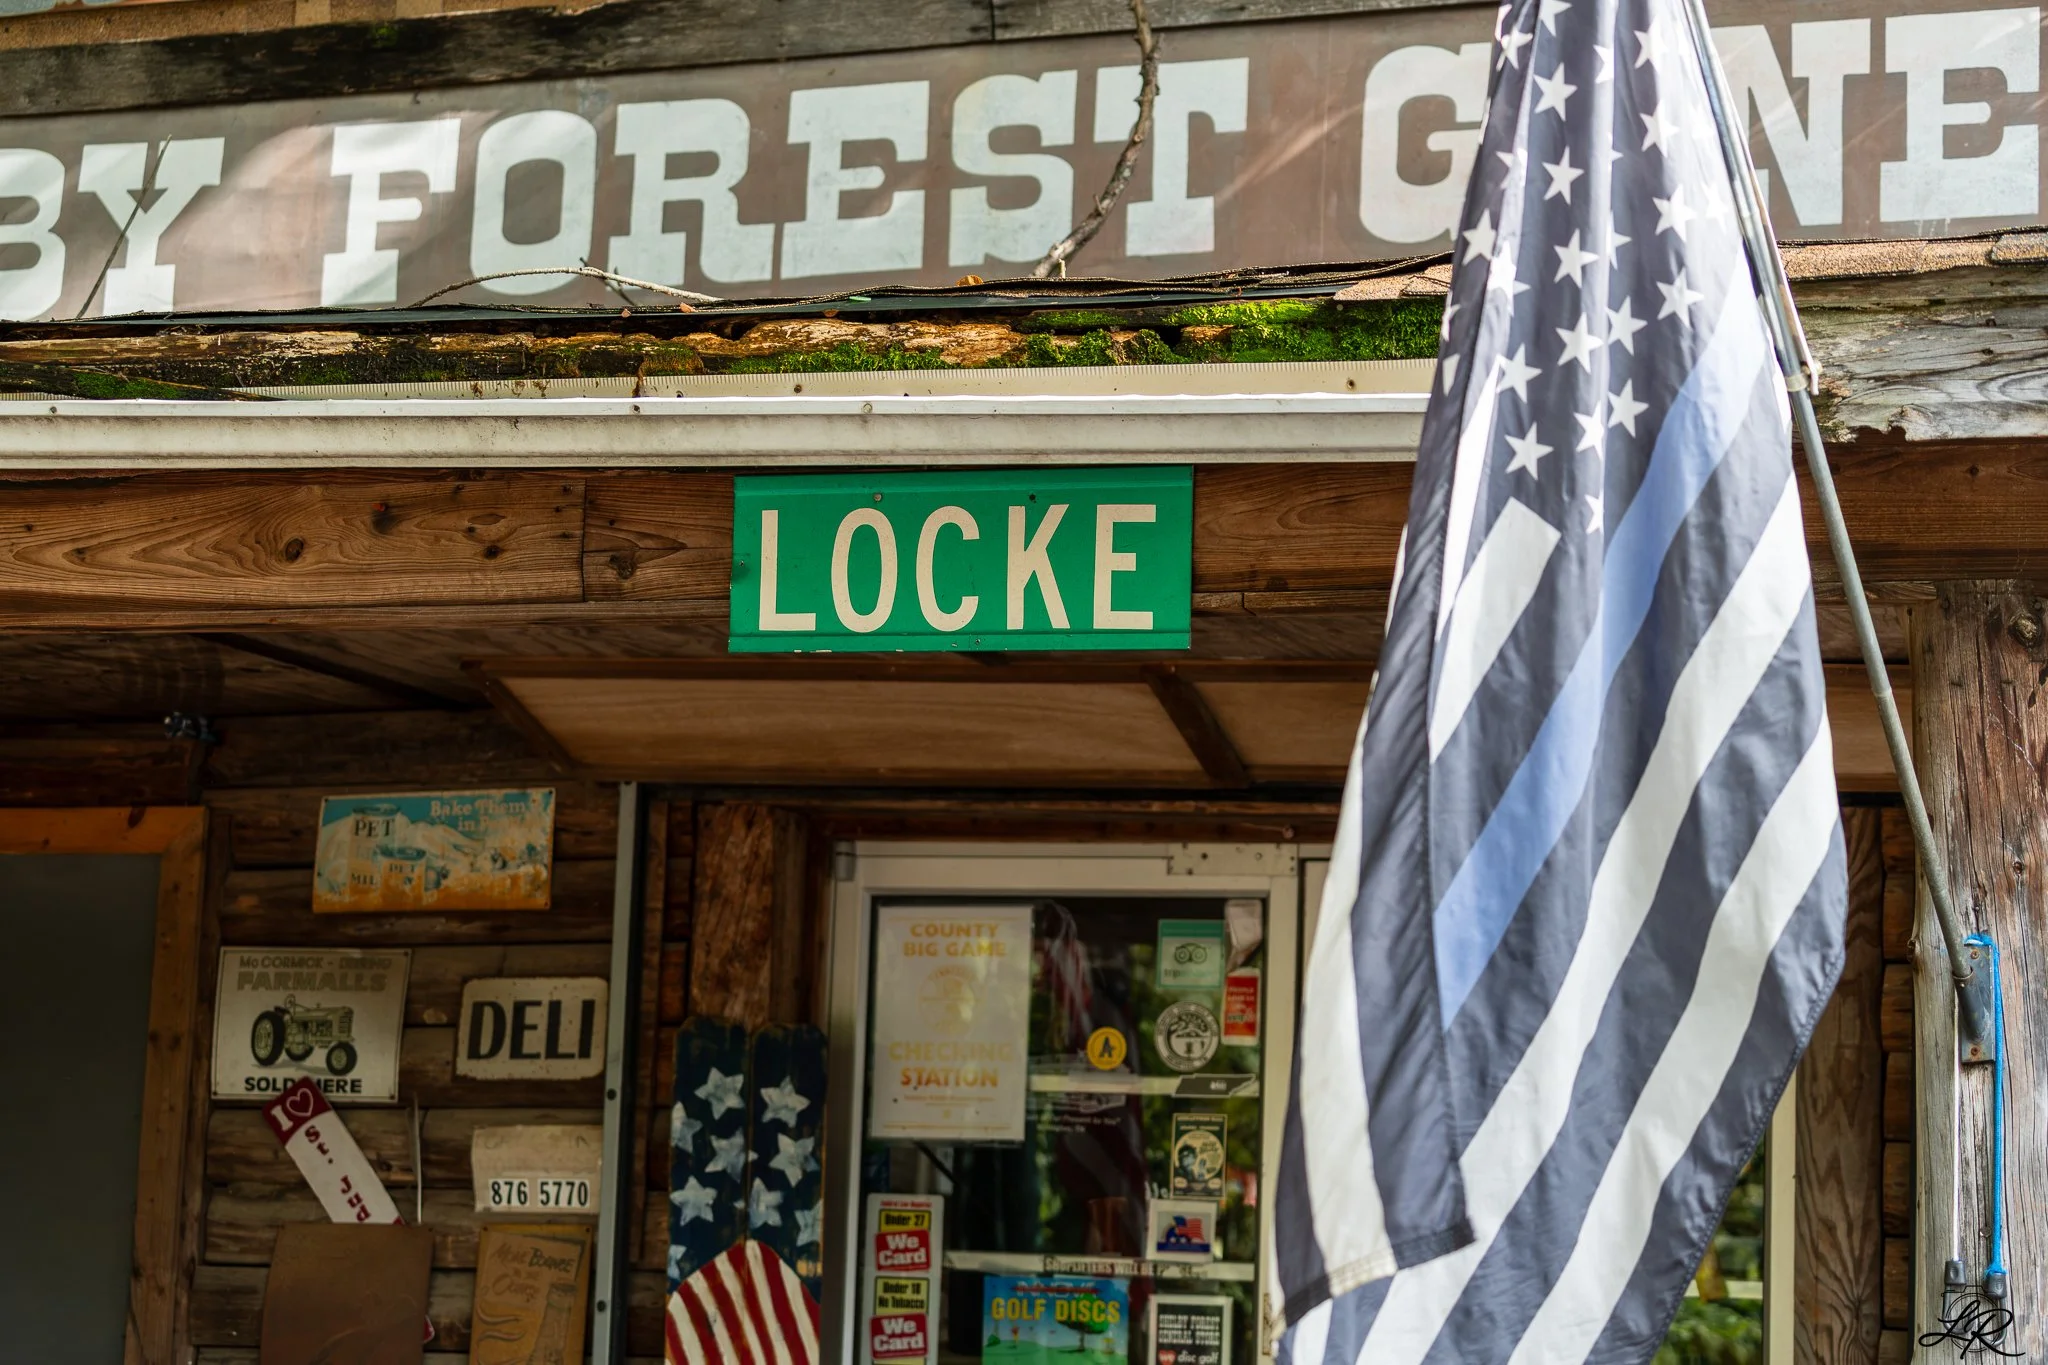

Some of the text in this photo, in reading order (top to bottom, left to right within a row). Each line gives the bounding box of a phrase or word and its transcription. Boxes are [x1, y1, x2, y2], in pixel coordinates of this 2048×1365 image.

[322, 57, 1249, 306] FOREST
[1360, 7, 2040, 244] GNE
[759, 504, 1157, 633] LOCKE
[431, 801, 471, 817] Bake
[354, 818, 395, 838] PET
[351, 872, 378, 886] MIL
[910, 923, 999, 938] COUNTY
[904, 942, 1007, 957] BIG GAME
[237, 971, 388, 992] FARMALLS
[466, 999, 596, 1061] DELI
[888, 1041, 1013, 1062] CHECKING
[245, 1076, 297, 1092] SOLD
[900, 1067, 998, 1088] STATION
[270, 1104, 294, 1133] I
[304, 1124, 371, 1222] St. Jud
[491, 1180, 589, 1207] 876 5770
[885, 1232, 919, 1250] We
[878, 1247, 927, 1266] Card
[991, 1297, 1121, 1324] GOLF DISCS
[880, 1317, 917, 1336] We
[873, 1332, 925, 1353] Card
[1178, 1349, 1197, 1363] disc
[1198, 1351, 1220, 1365] golf
